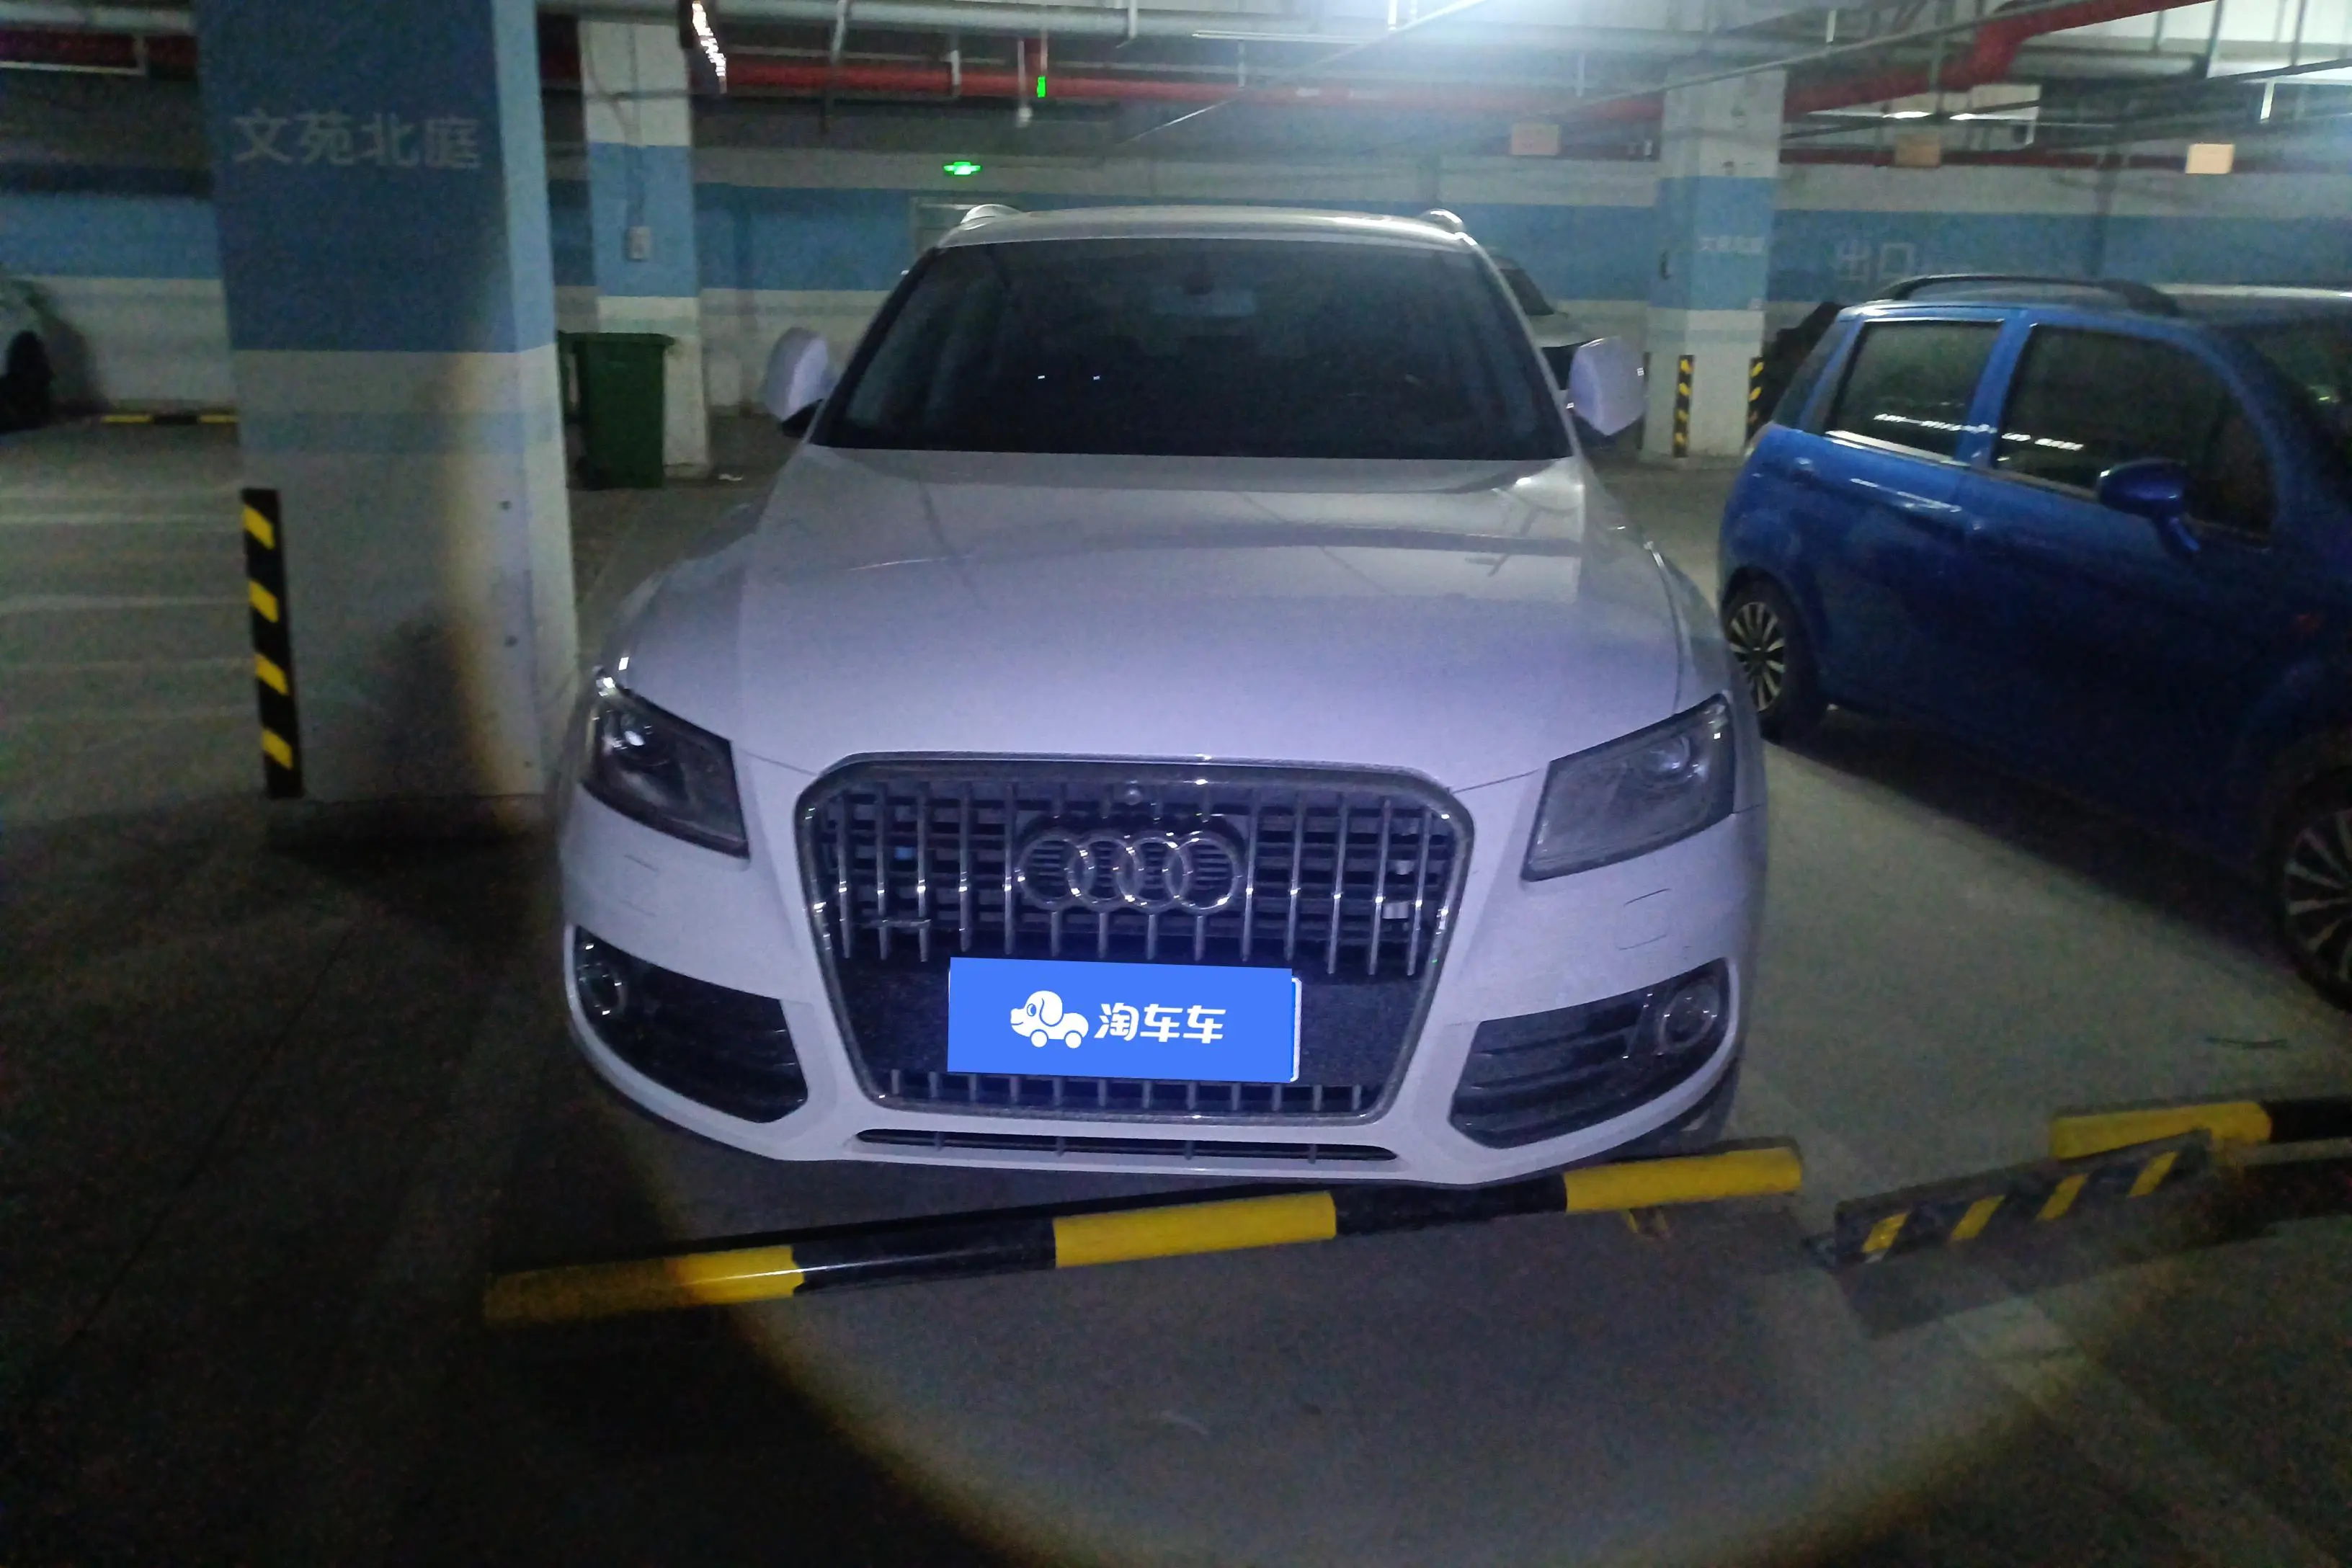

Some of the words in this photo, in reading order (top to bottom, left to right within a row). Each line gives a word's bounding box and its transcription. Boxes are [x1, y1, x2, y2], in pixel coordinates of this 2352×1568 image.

[232, 107, 483, 170] 文苑北庭
[1835, 239, 1916, 282] 出口
